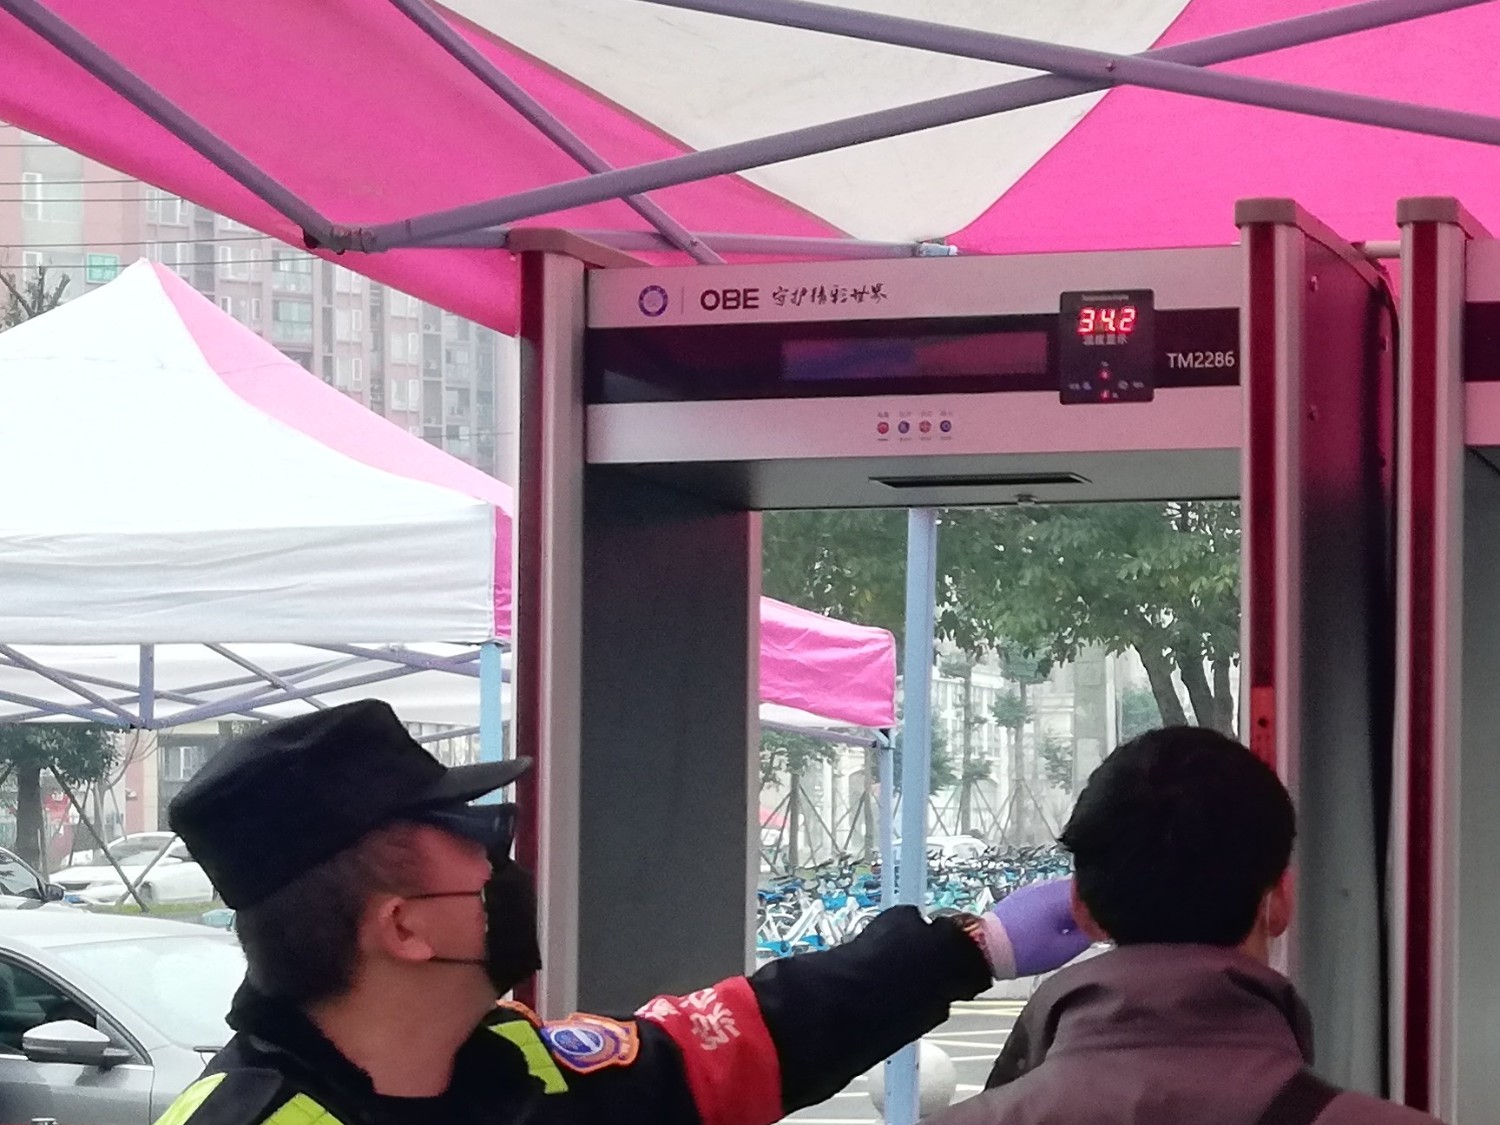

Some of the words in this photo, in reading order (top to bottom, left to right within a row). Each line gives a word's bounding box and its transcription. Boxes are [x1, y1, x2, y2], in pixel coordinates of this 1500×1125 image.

[700, 288, 760, 312] OBE
[772, 282, 888, 307] 守护精彩世界
[1166, 351, 1235, 369] TM2286
